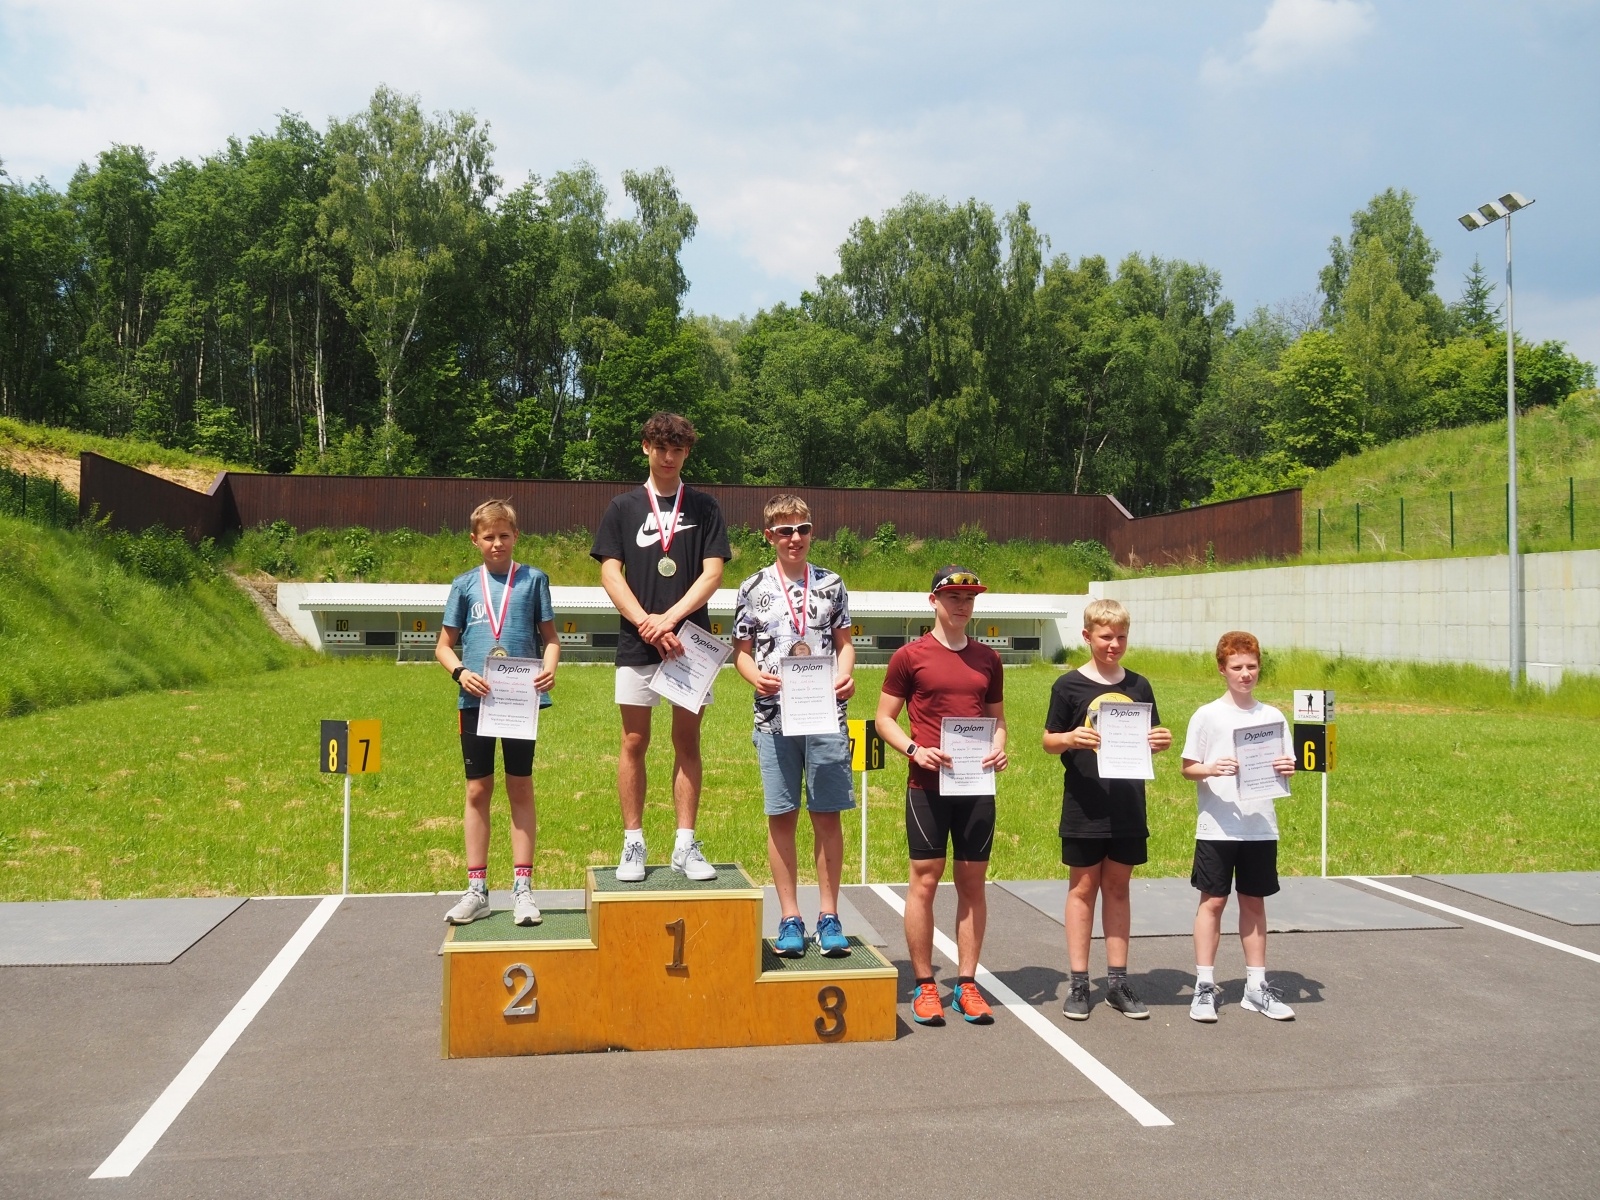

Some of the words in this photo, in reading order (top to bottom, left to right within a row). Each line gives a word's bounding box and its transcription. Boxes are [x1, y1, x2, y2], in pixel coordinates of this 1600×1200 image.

[337, 620, 348, 631] 10
[416, 620, 422, 631] 9
[567, 622, 573, 633] 7
[713, 623, 719, 634] 5
[854, 625, 860, 636] 3
[690, 633, 719, 653] Dyplom
[497, 664, 531, 674] Dyplom
[791, 663, 823, 673] Dyplom
[1110, 708, 1140, 718] Dyplom
[953, 724, 984, 734] Dyplom
[1244, 730, 1274, 741] Dyplom
[328, 738, 338, 772] 8
[359, 739, 370, 772] 7
[871, 737, 879, 769] 6
[1303, 740, 1316, 771] 6
[665, 917, 688, 971] 1
[503, 962, 538, 1018] 2
[814, 985, 847, 1037] 3
